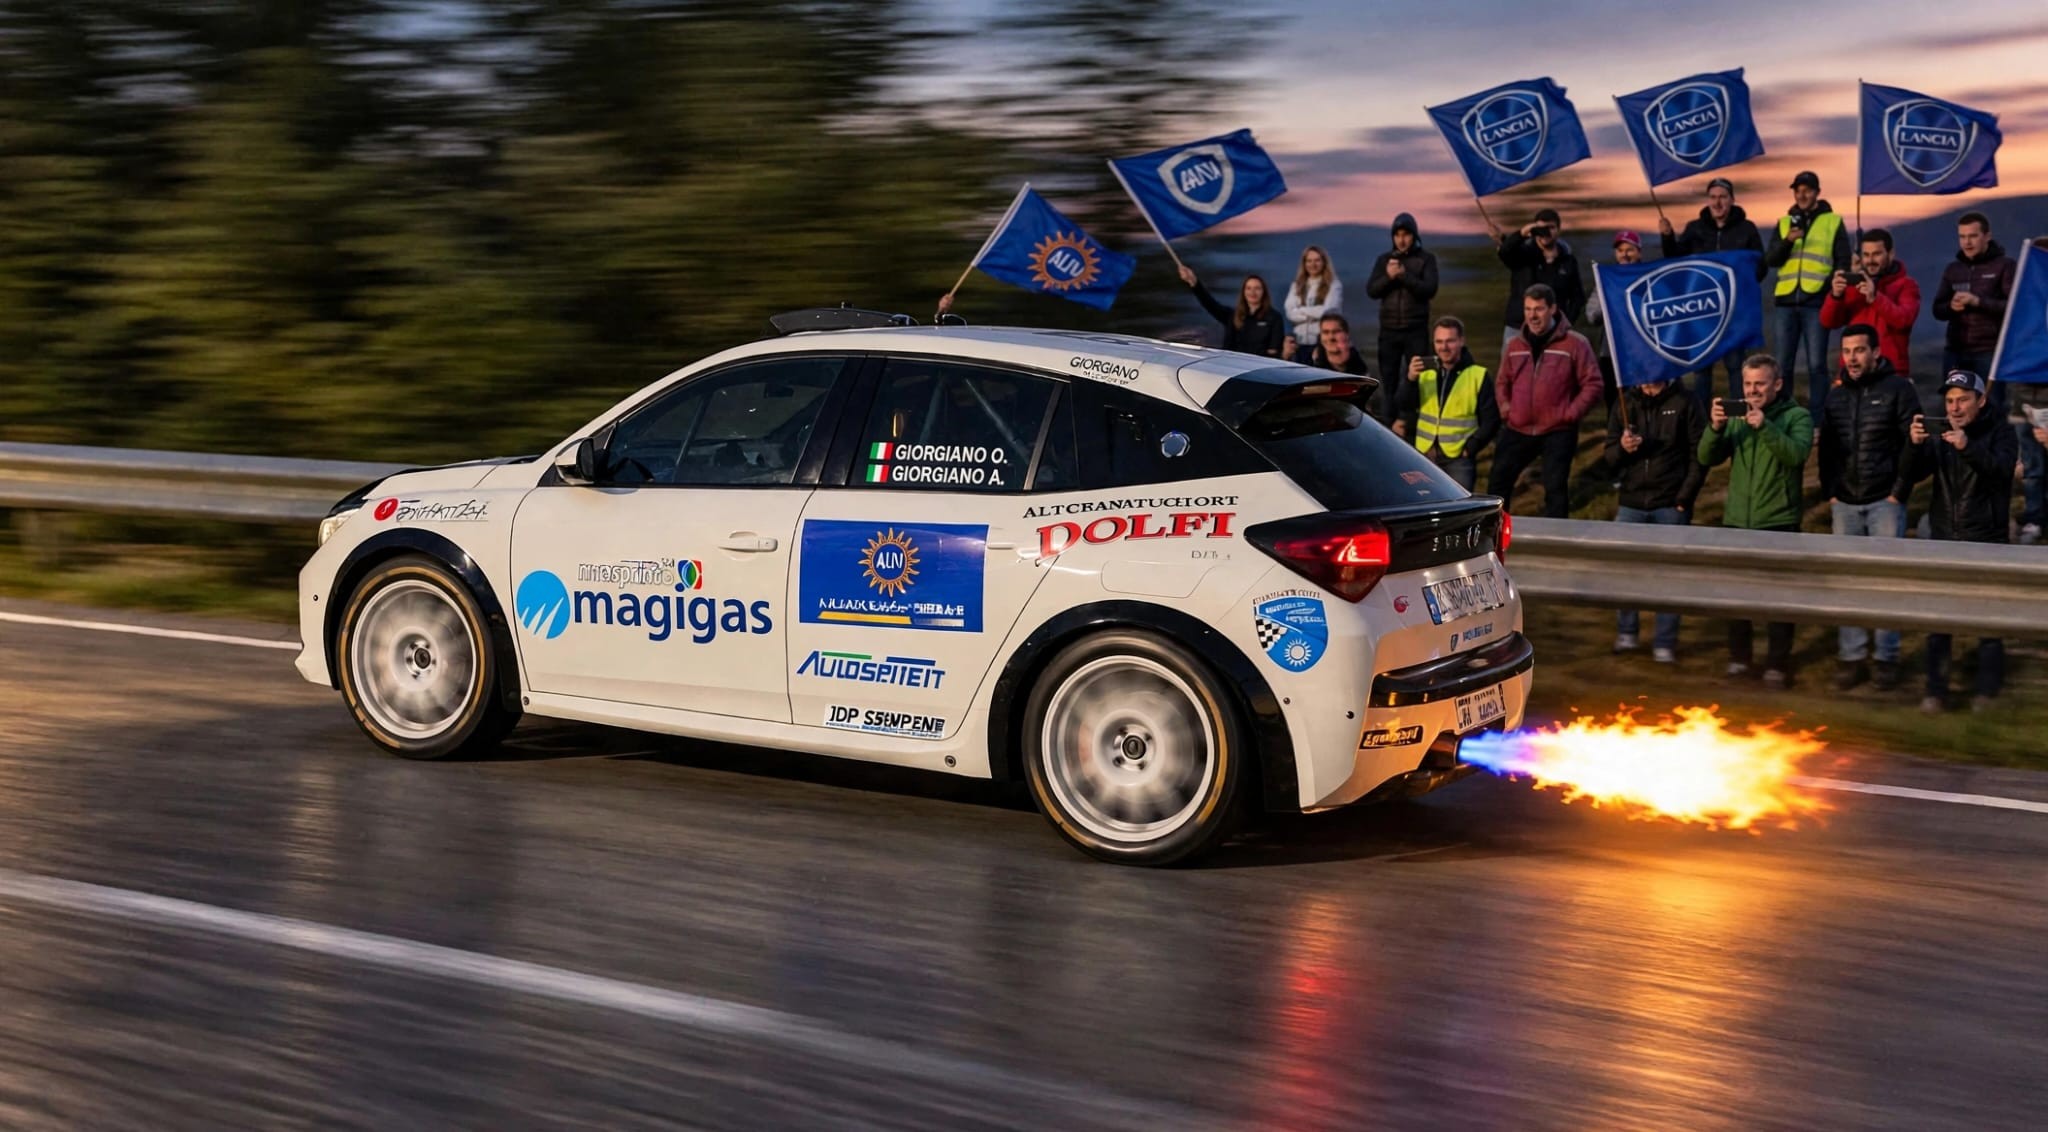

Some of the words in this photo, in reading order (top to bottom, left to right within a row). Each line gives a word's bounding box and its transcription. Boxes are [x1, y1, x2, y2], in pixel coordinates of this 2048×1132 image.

[1483, 117, 1535, 143] LANCIA
[1664, 110, 1717, 135] LANCIA
[1900, 131, 1957, 148] LANCIA
[1649, 297, 1718, 320] LANCIA
[1070, 356, 1140, 381] GIORGIANO
[895, 444, 987, 463] GIORGIANO
[990, 447, 1008, 465] O.
[892, 465, 985, 484] GIORGIANO
[987, 468, 1005, 486] A.
[1036, 512, 1236, 560] DOLFI
[573, 582, 773, 645] magigas
